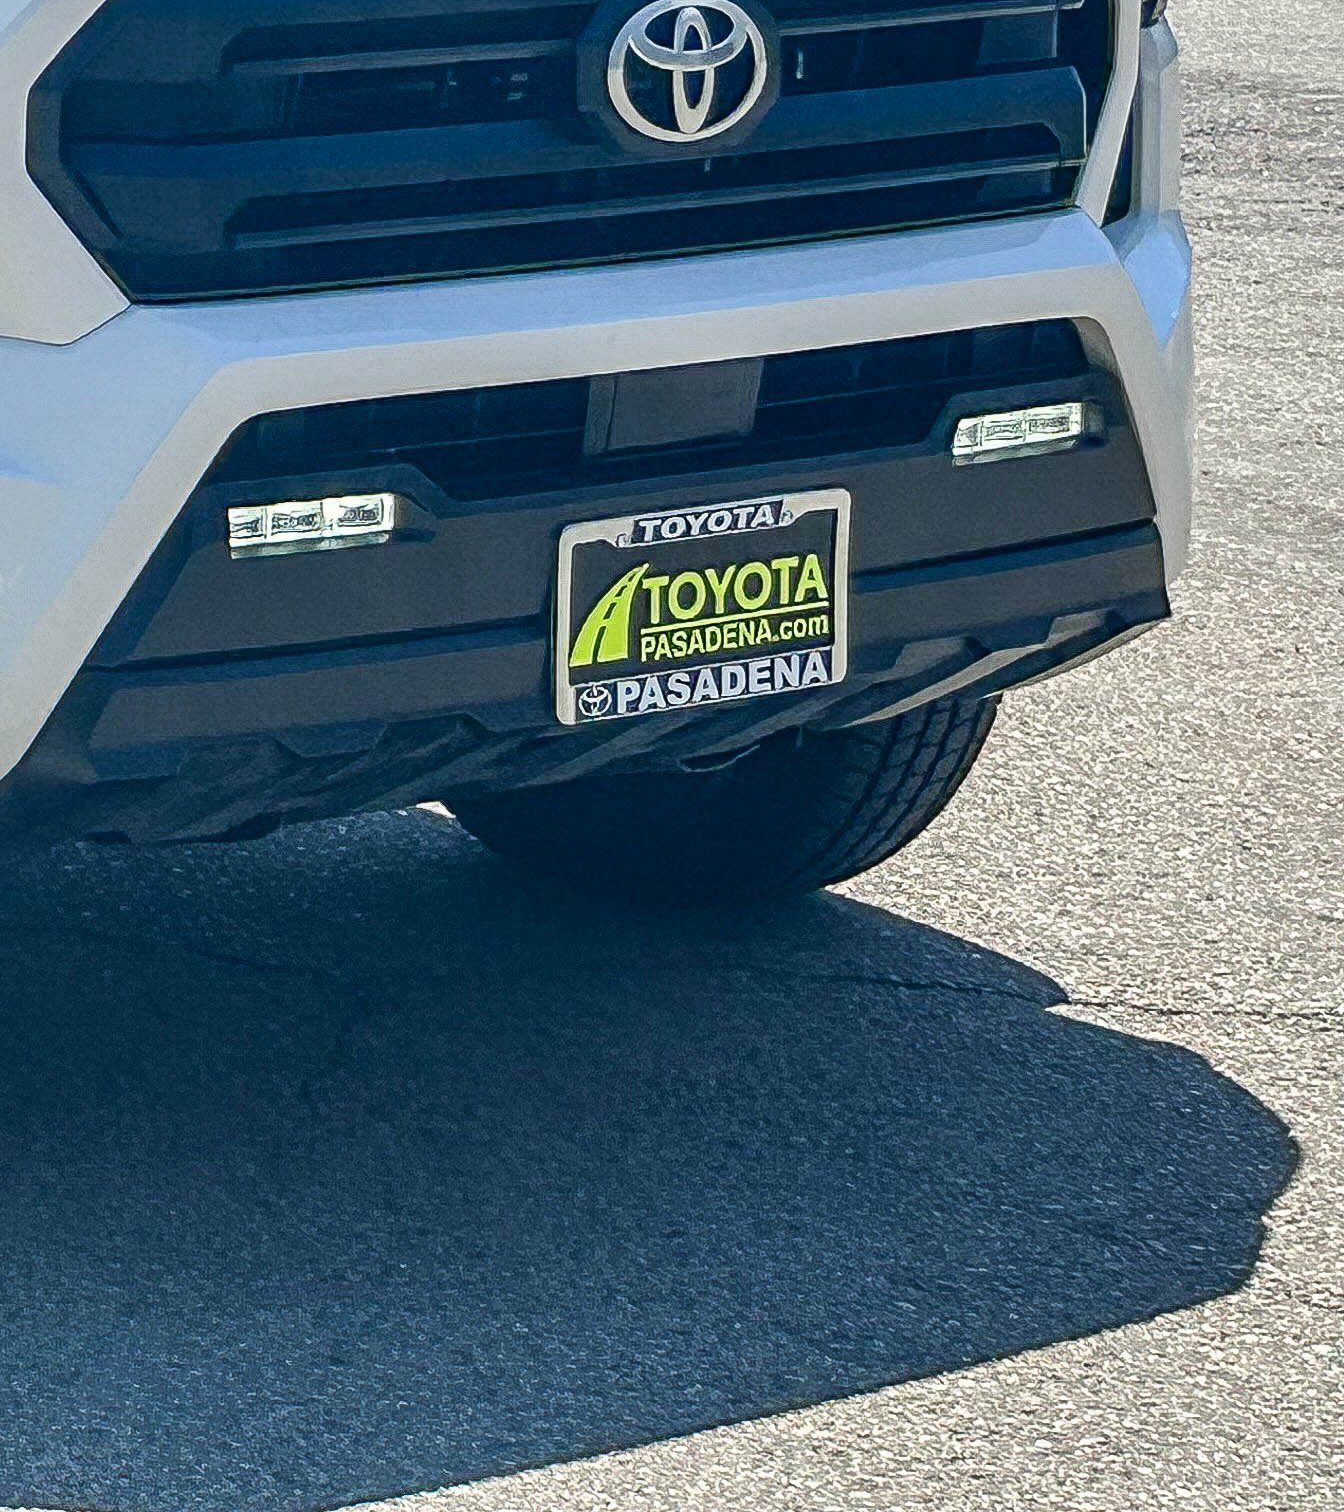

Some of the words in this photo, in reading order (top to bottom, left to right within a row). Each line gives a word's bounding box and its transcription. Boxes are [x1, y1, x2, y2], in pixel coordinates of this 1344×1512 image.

[638, 502, 774, 543] TOYOTA
[640, 552, 829, 625] TOYOTA
[640, 614, 830, 662] PASADENA.com
[616, 651, 829, 714] PASADENA
